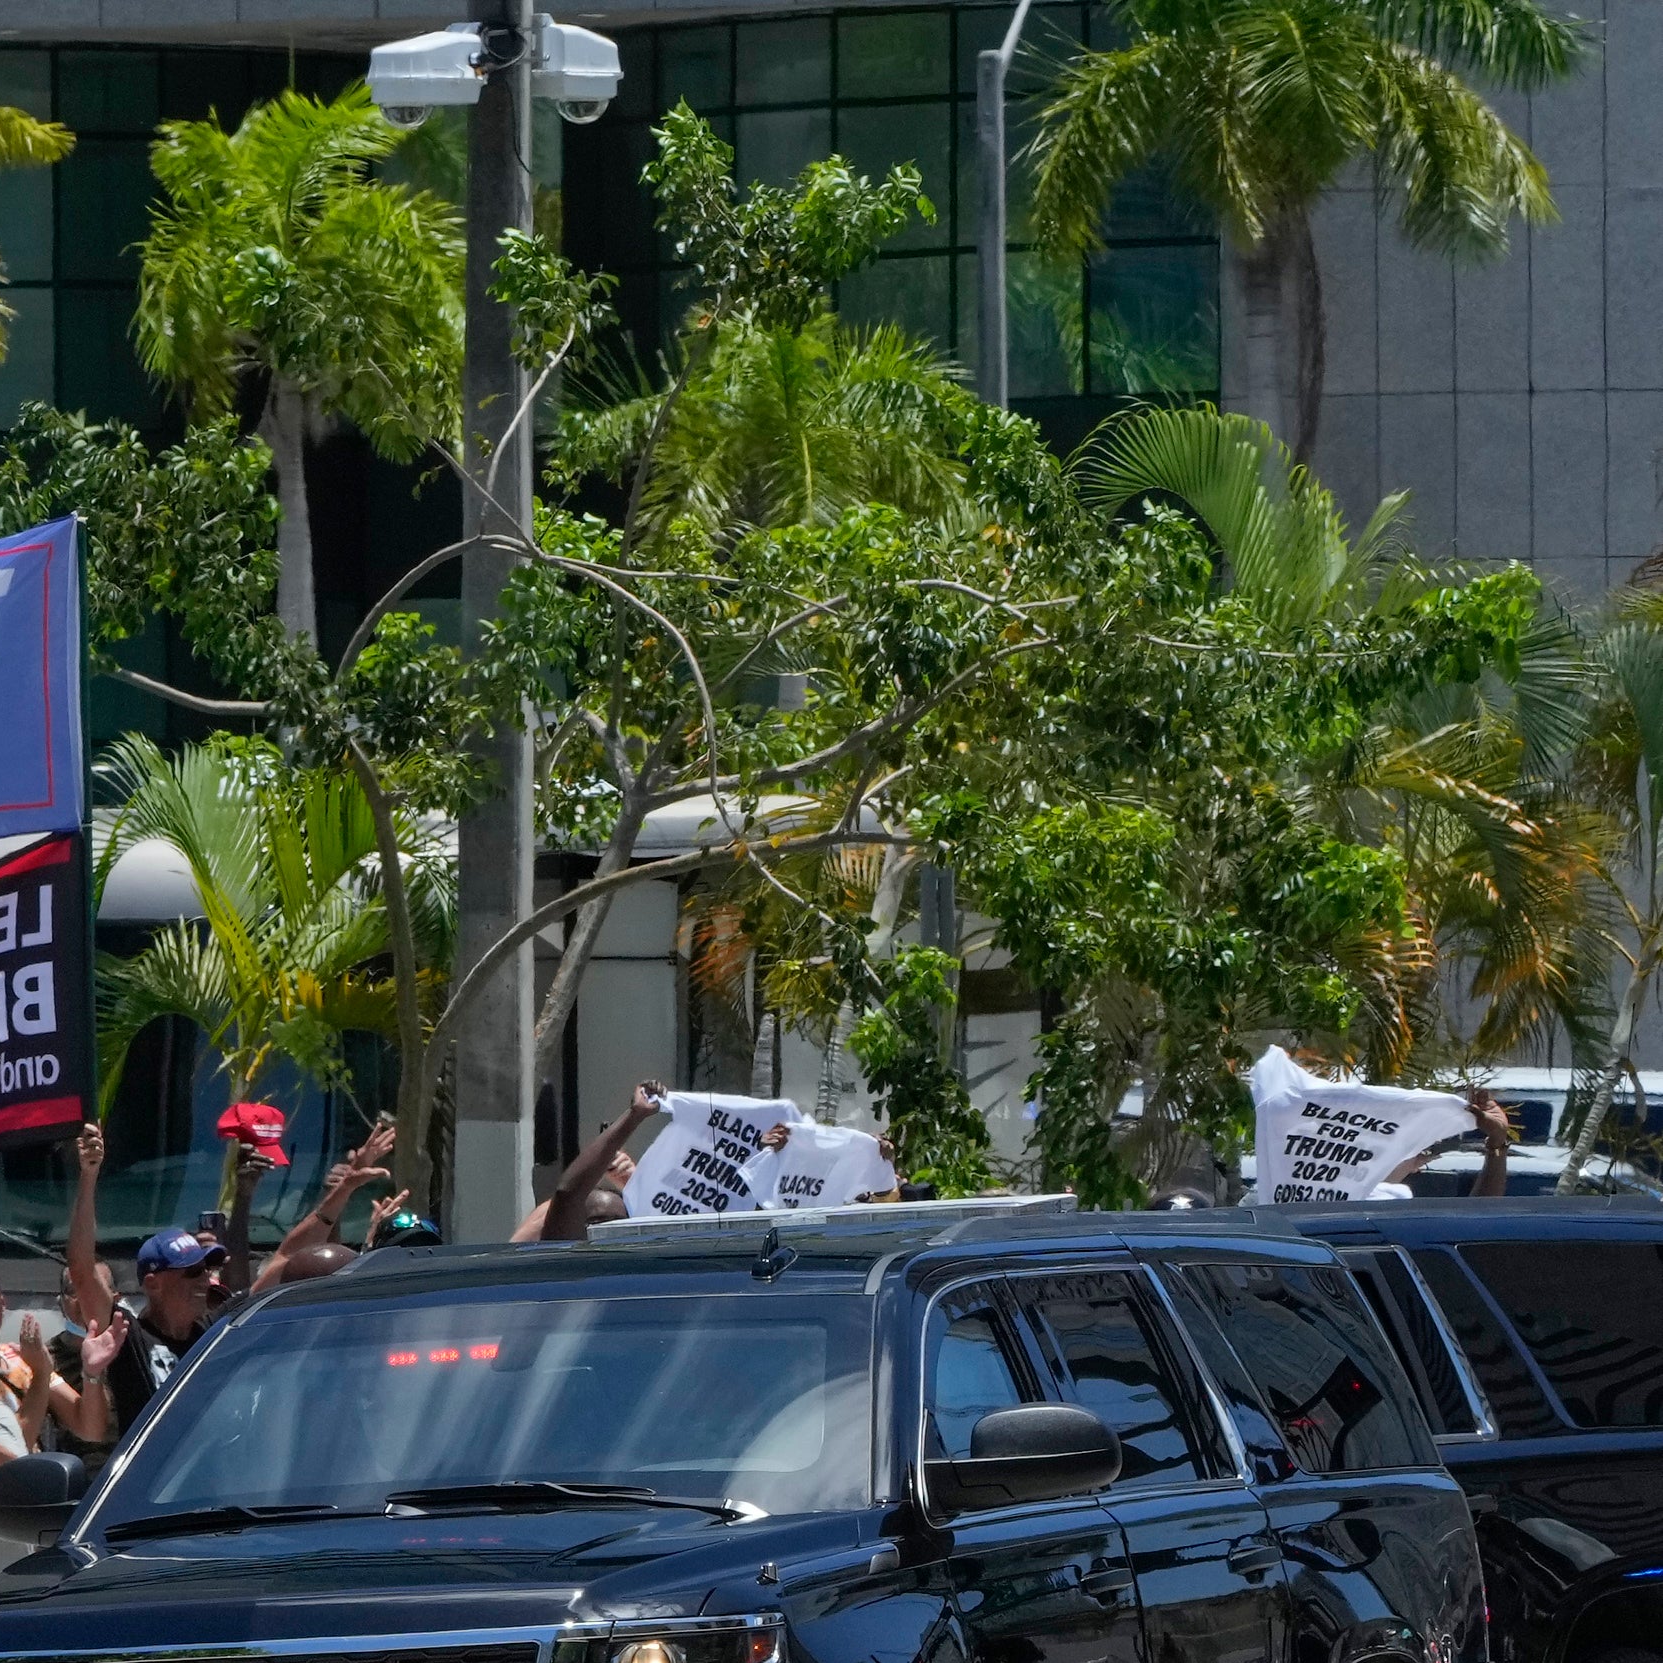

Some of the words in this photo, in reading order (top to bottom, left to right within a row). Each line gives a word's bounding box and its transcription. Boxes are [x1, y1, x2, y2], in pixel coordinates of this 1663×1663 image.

[707, 1109, 763, 1151] BLACK
[1301, 1102, 1400, 1135] BLACKS
[1317, 1123, 1360, 1142] FOR
[713, 1137, 751, 1164] FOR
[1285, 1134, 1373, 1166] TRUMP
[1292, 1161, 1341, 1182] 2020
[680, 1177, 729, 1212] 2020
